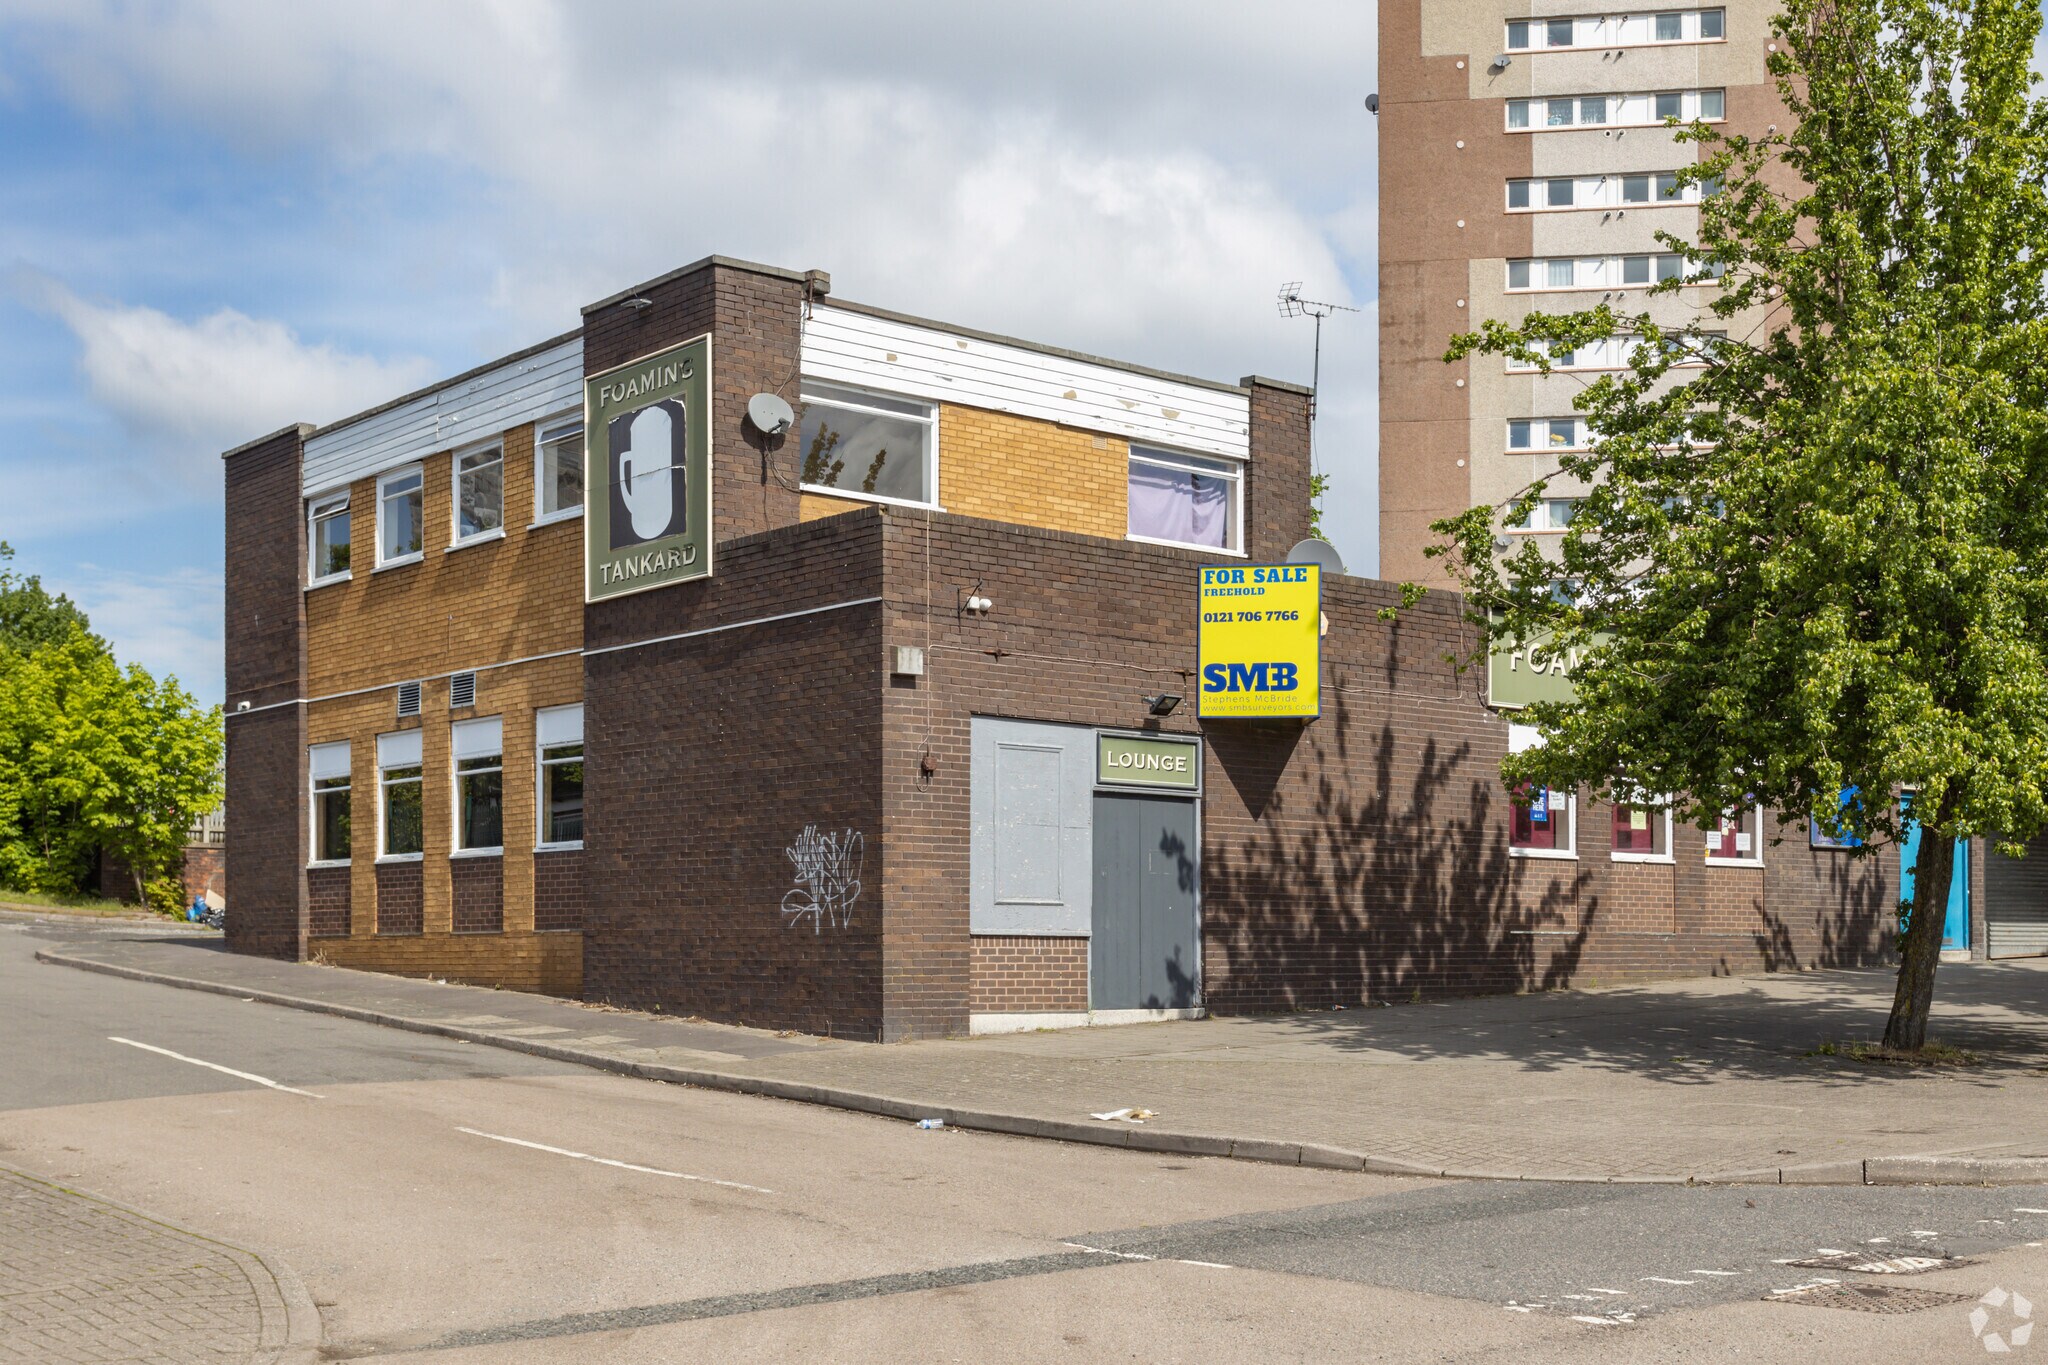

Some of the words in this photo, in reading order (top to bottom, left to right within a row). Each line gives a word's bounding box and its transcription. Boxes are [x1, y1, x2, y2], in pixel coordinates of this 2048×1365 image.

[601, 358, 694, 408] FOAMING
[600, 544, 697, 585] TANKARD
[1204, 569, 1245, 585] FOR
[1253, 567, 1308, 583] SALE
[1204, 587, 1266, 597] FREEHOLD
[1203, 612, 1234, 623] 0121
[1237, 611, 1263, 622] 706
[1265, 610, 1299, 621] 7766
[1203, 662, 1299, 693] SMB
[1203, 694, 1250, 704] Stephens
[1254, 694, 1298, 703] McBride
[1107, 750, 1188, 773] LOUNGE
